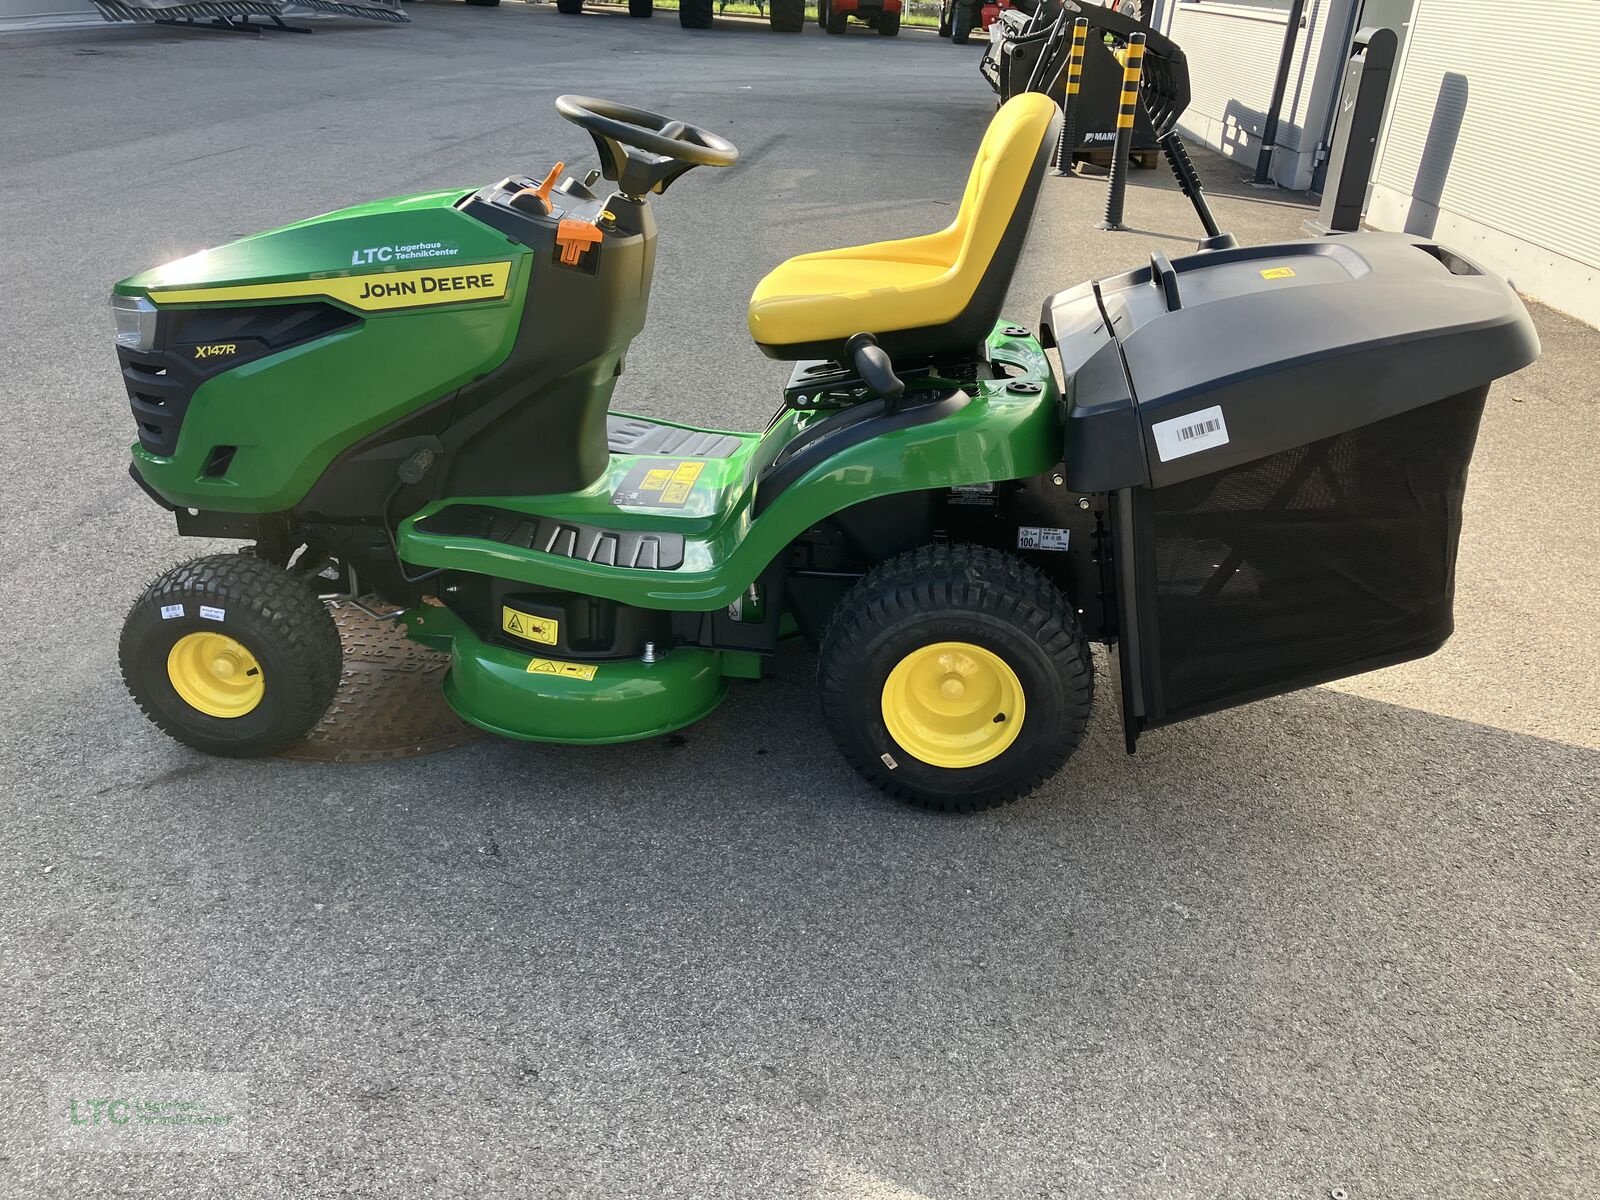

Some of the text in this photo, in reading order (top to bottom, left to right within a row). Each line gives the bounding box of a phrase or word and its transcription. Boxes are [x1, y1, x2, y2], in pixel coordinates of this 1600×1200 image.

[395, 242, 441, 252] Lagerhaus
[352, 247, 393, 266] LTC
[395, 248, 458, 260] TechnikCenter
[360, 273, 495, 299] JOHN DEERE
[195, 344, 236, 358] X147R
[1020, 537, 1034, 547] 100
